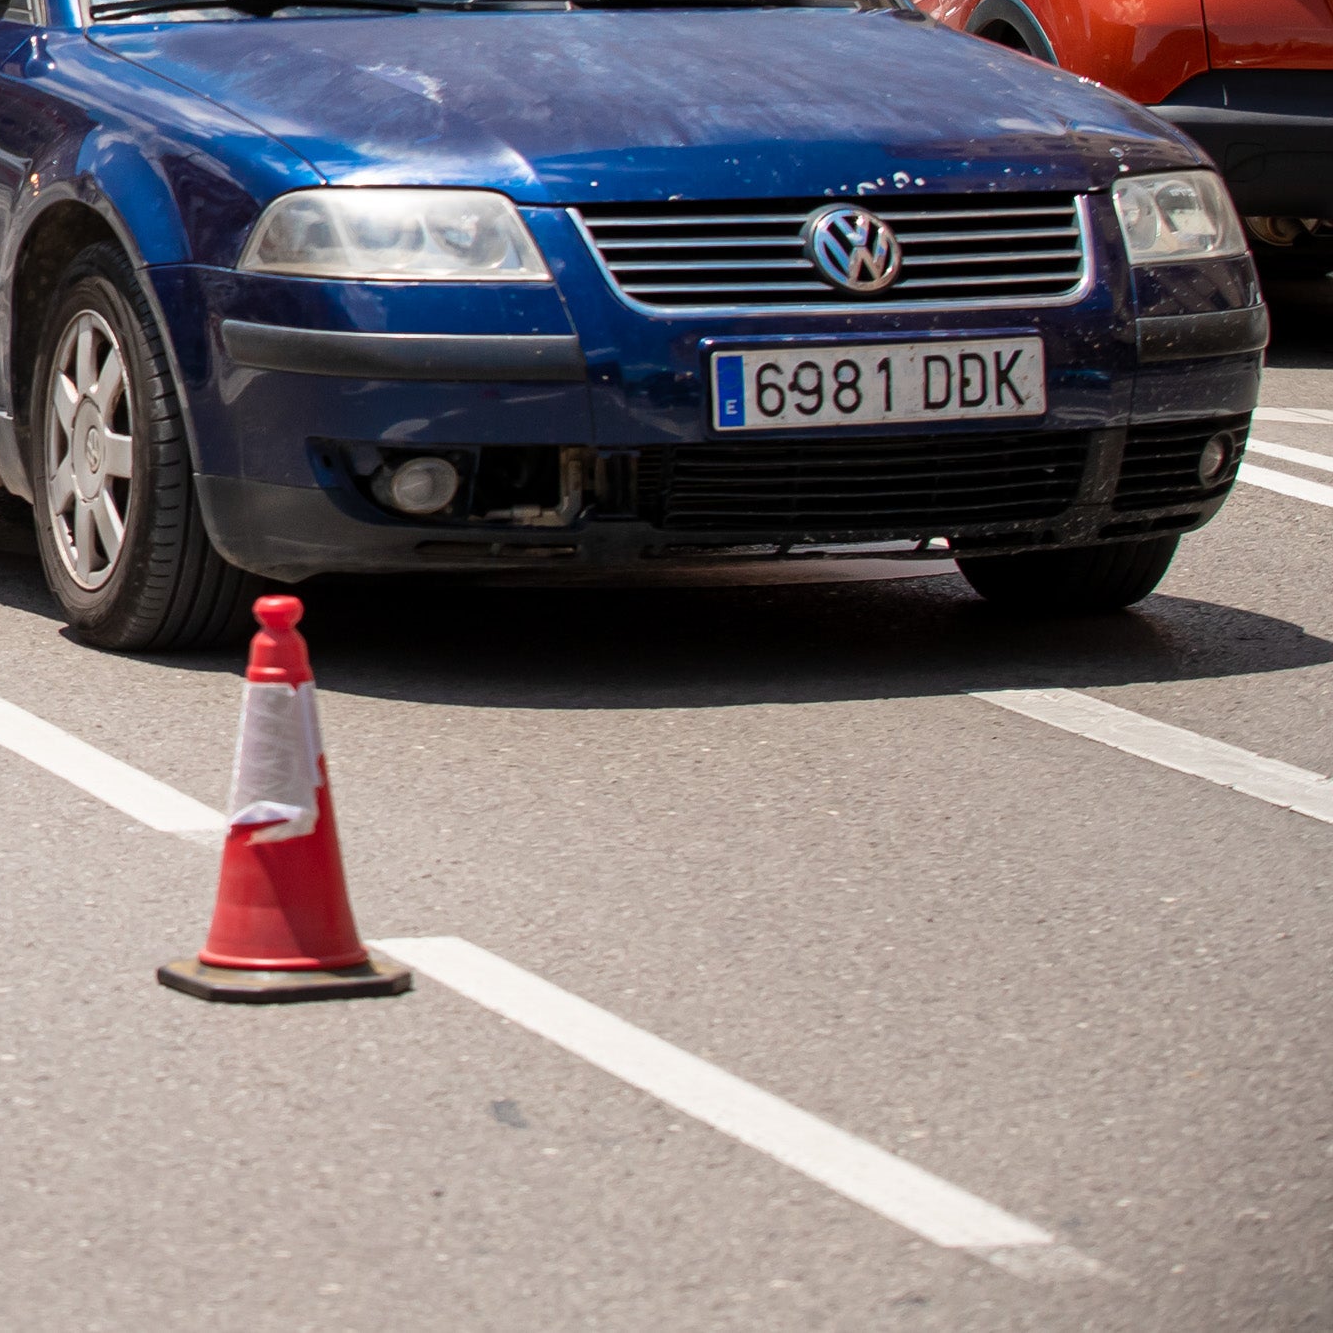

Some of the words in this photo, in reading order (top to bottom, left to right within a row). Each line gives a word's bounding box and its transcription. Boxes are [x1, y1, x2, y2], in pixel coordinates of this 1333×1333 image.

[725, 399, 739, 415] E
[755, 357, 893, 417] 6981
[923, 349, 1025, 410] DDK
